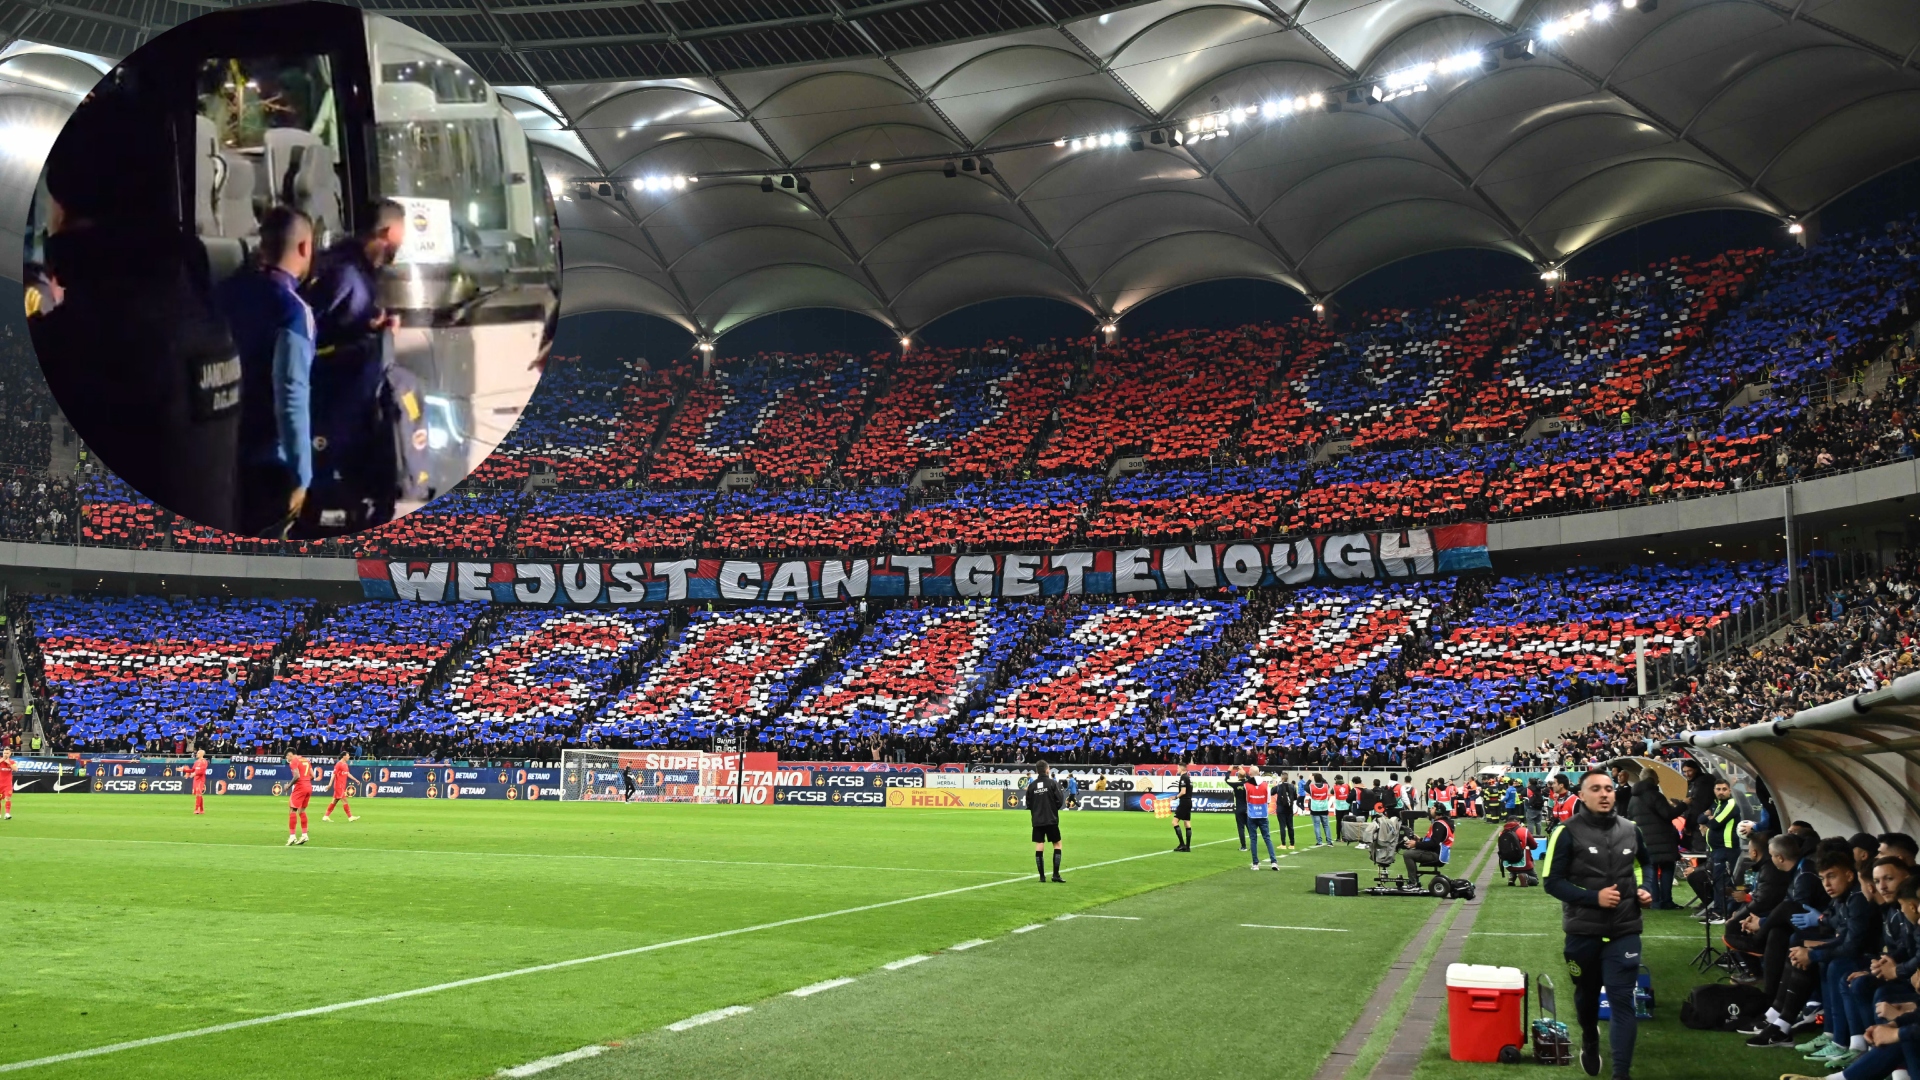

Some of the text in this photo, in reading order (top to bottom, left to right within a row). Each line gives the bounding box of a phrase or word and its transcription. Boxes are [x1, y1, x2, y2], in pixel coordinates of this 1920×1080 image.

[388, 529, 1440, 605] WE JUST CAN'T GET ENOUGH
[16, 761, 53, 770] EDRU
[645, 753, 747, 771] SUPERBET
[123, 767, 146, 775] BETANO
[254, 768, 277, 776] BETANO
[301, 761, 310, 777] 7
[389, 771, 413, 779] BETANO
[455, 772, 478, 780] BETANO
[527, 772, 550, 780] BETANO
[663, 774, 688, 782] BETANO
[726, 771, 803, 787] BETANO
[104, 780, 137, 791] FCSB
[150, 780, 183, 791] FCSB
[827, 775, 864, 787] FCSB
[884, 777, 923, 788] FCSB
[973, 775, 1011, 787] Himalaya
[227, 783, 252, 791] BETANO
[378, 785, 404, 794] BETANO
[459, 787, 486, 795] BETANO
[540, 788, 566, 796] BETANO
[692, 785, 768, 804] BETANO
[786, 790, 827, 802] FCSB
[842, 792, 884, 803] FCSB
[911, 795, 962, 807] HELIX
[1080, 796, 1121, 808] FCSB
